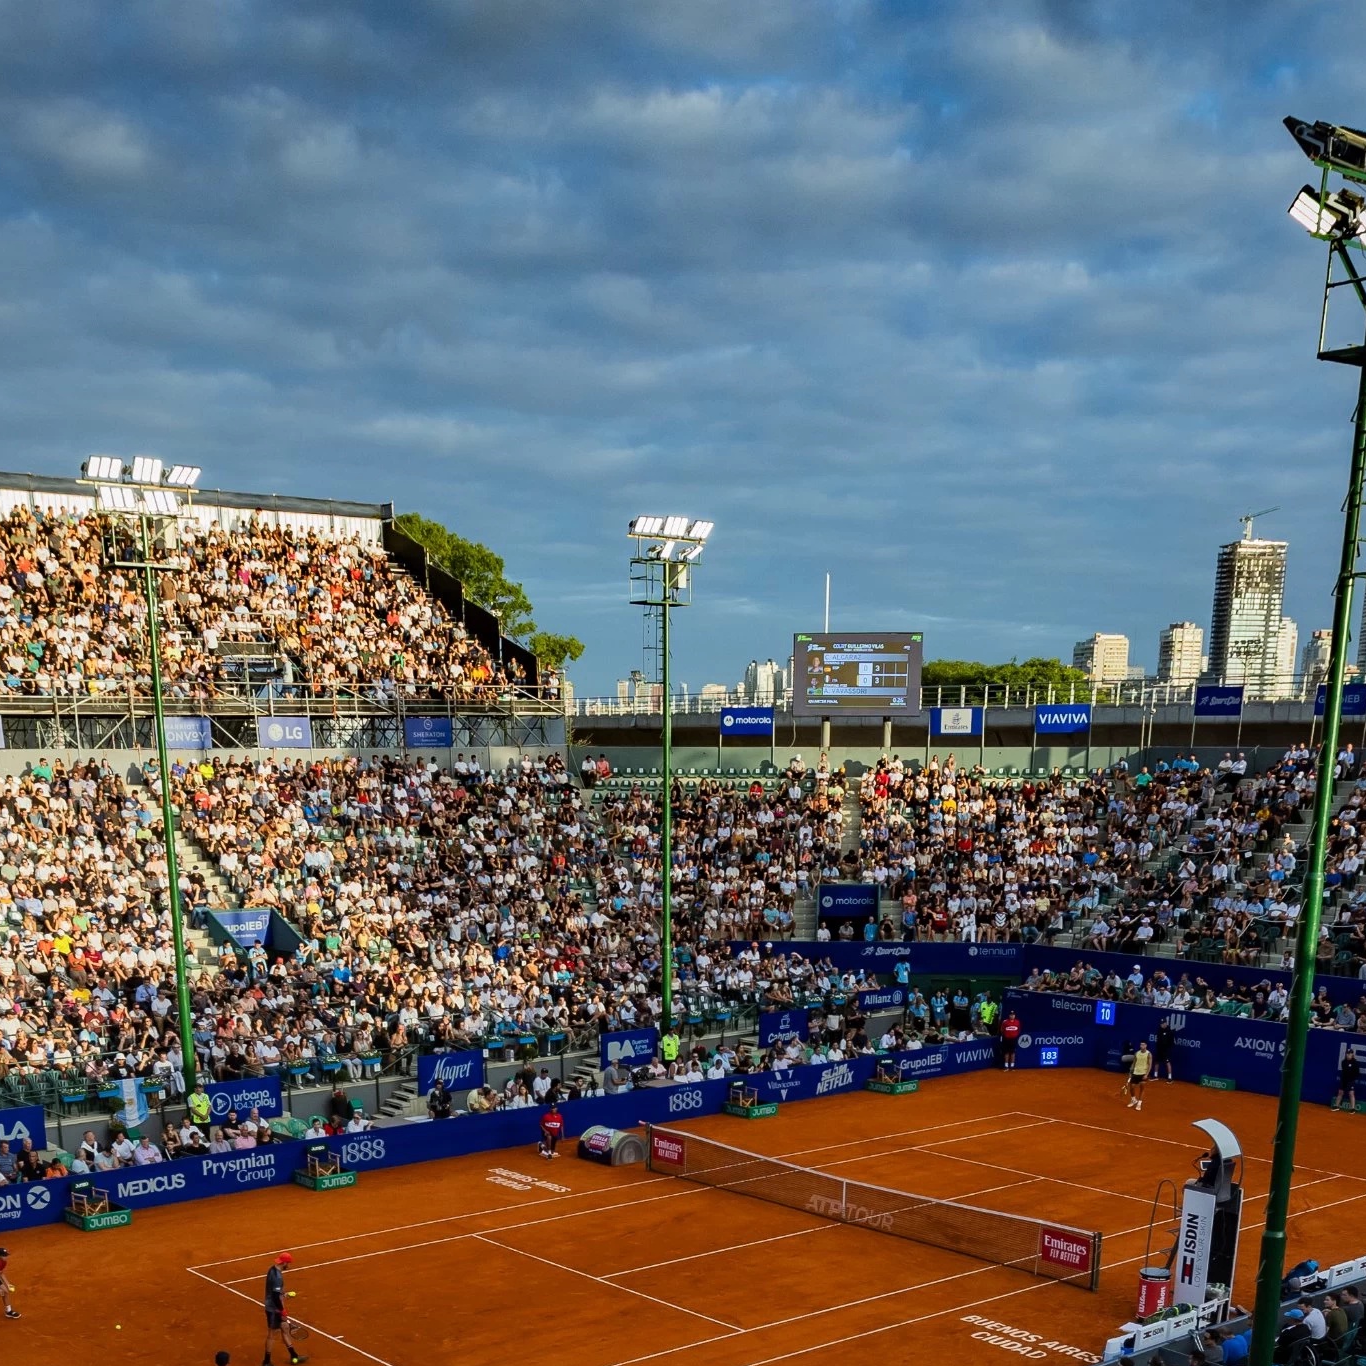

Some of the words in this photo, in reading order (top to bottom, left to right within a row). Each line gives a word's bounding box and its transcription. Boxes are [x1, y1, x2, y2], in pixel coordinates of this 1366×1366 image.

[1209, 695, 1241, 706] SportClub
[736, 716, 772, 725] motorola
[1039, 712, 1089, 725] VIAVIVA
[166, 723, 201, 731] ARRIOTT
[285, 726, 303, 740] LG
[944, 723, 969, 731] Emirates
[166, 731, 207, 743] ONVOY
[835, 898, 875, 906] motorola
[225, 920, 263, 935] upoIEB
[876, 945, 911, 957] SportClub
[978, 947, 1017, 957] tennium
[864, 994, 892, 1005] Allianz
[1051, 998, 1093, 1013] telecom
[1100, 1008, 1111, 1021] 10
[768, 1030, 801, 1044] Cabrales
[1034, 1035, 1085, 1046] motorola
[1149, 1033, 1202, 1049] BEARRIOR
[1233, 1035, 1277, 1051] AXION
[607, 1040, 636, 1061] BA
[636, 1048, 654, 1056] Ciudad
[955, 1047, 995, 1064] VIAVIVA
[1041, 1051, 1058, 1061] 183
[1255, 1050, 1274, 1059] energy
[900, 1053, 943, 1070] GrupoIEB
[427, 1055, 475, 1089] Magret
[815, 1071, 854, 1095] NETFLIX
[867, 1083, 892, 1093] JUMBO
[896, 1082, 917, 1093] JUMBO
[1202, 1080, 1227, 1089] JUMBO
[233, 1089, 271, 1102] urbana
[254, 1096, 277, 1110] play
[668, 1090, 704, 1113] 1888
[752, 1105, 777, 1117] JUMBO
[341, 1138, 387, 1164] 1888
[654, 1137, 682, 1153] Emirates
[202, 1153, 276, 1179] Prysmian
[236, 1166, 277, 1183] Group
[321, 1174, 355, 1189] JUMBO
[487, 1167, 538, 1183] BUENOS
[531, 1180, 572, 1193] AIRES
[117, 1172, 186, 1199] MEDICUS
[485, 1176, 532, 1191] CIUDAD
[805, 1194, 843, 1217] ATP
[846, 1202, 895, 1231] TOUR
[89, 1214, 128, 1229] JUMBO
[1183, 1212, 1200, 1255] ISDIN
[1044, 1234, 1087, 1255] Emirates
[1049, 1249, 1060, 1260] FLY
[1059, 1251, 1080, 1265] BETTER
[1139, 1284, 1147, 1313] Wilson
[1182, 1316, 1195, 1327] ISDIN
[1151, 1326, 1164, 1337] ISDIN
[959, 1315, 1043, 1343] BUENOS
[1038, 1340, 1103, 1364] AIRES
[970, 1331, 1048, 1359] CIUDAD
